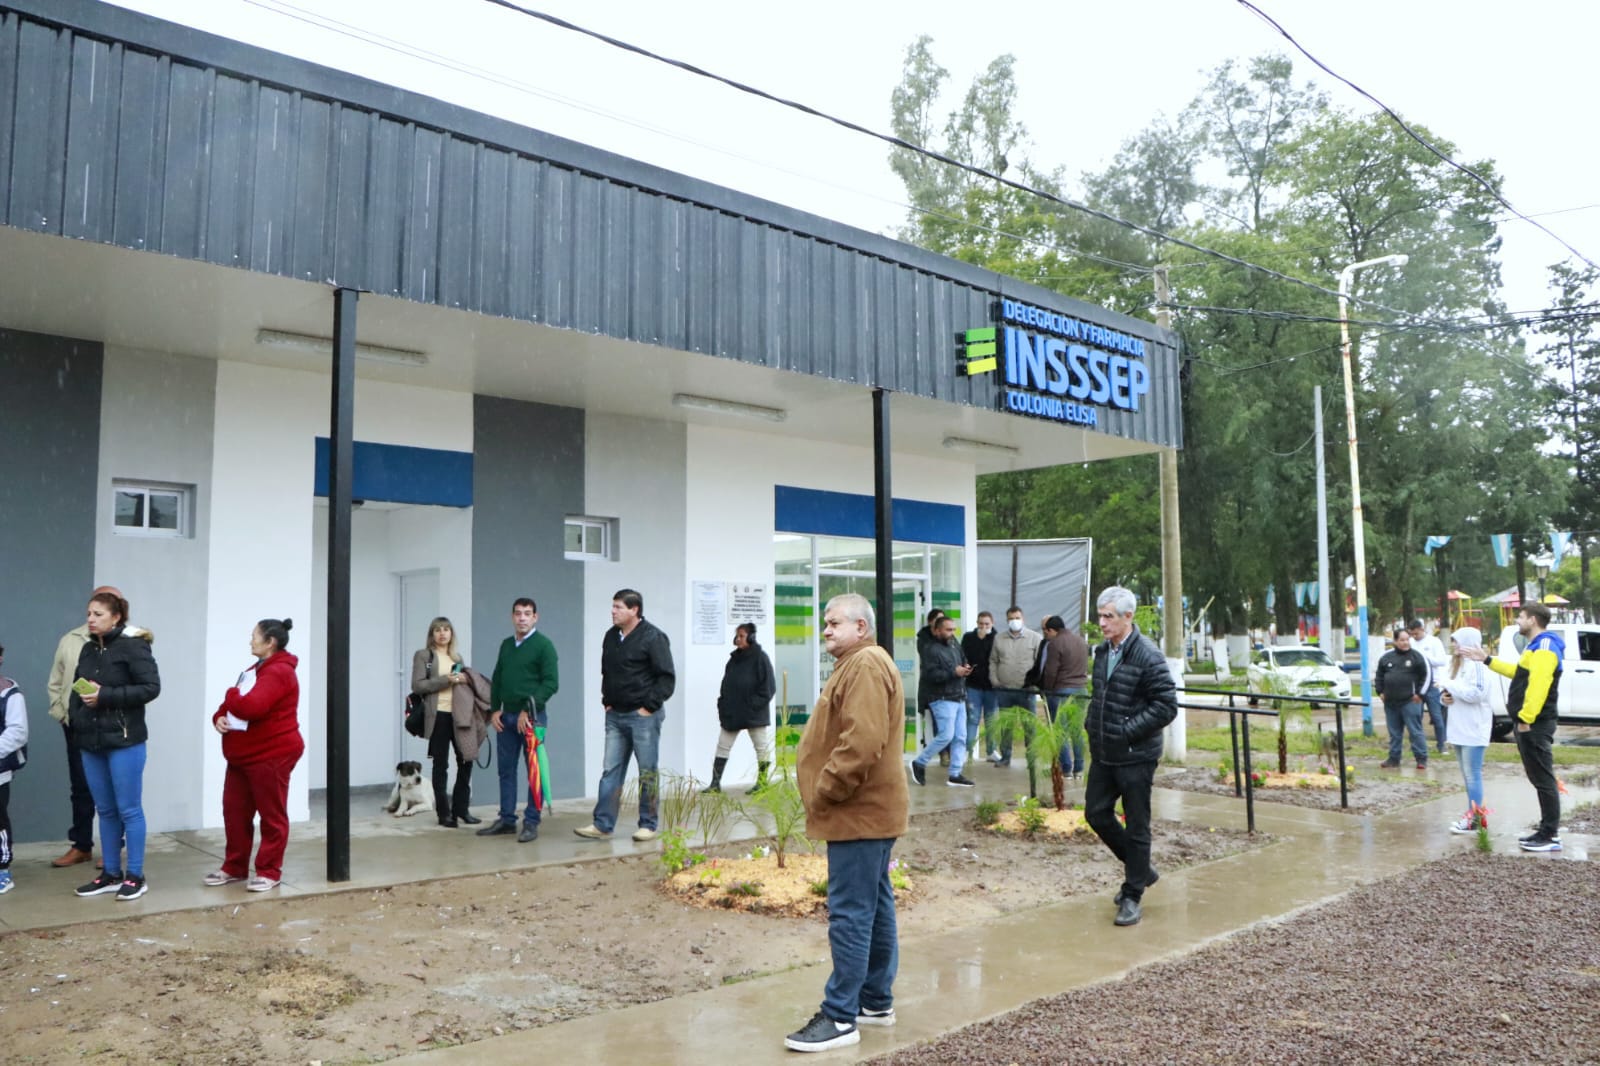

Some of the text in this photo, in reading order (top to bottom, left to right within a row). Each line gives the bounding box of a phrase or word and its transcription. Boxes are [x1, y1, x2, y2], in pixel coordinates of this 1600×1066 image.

[1003, 298, 1145, 357] DELEGACION Y FARMACIA
[1005, 327, 1150, 410] INSSSEP
[1008, 391, 1097, 425] COLONIA ELISA
